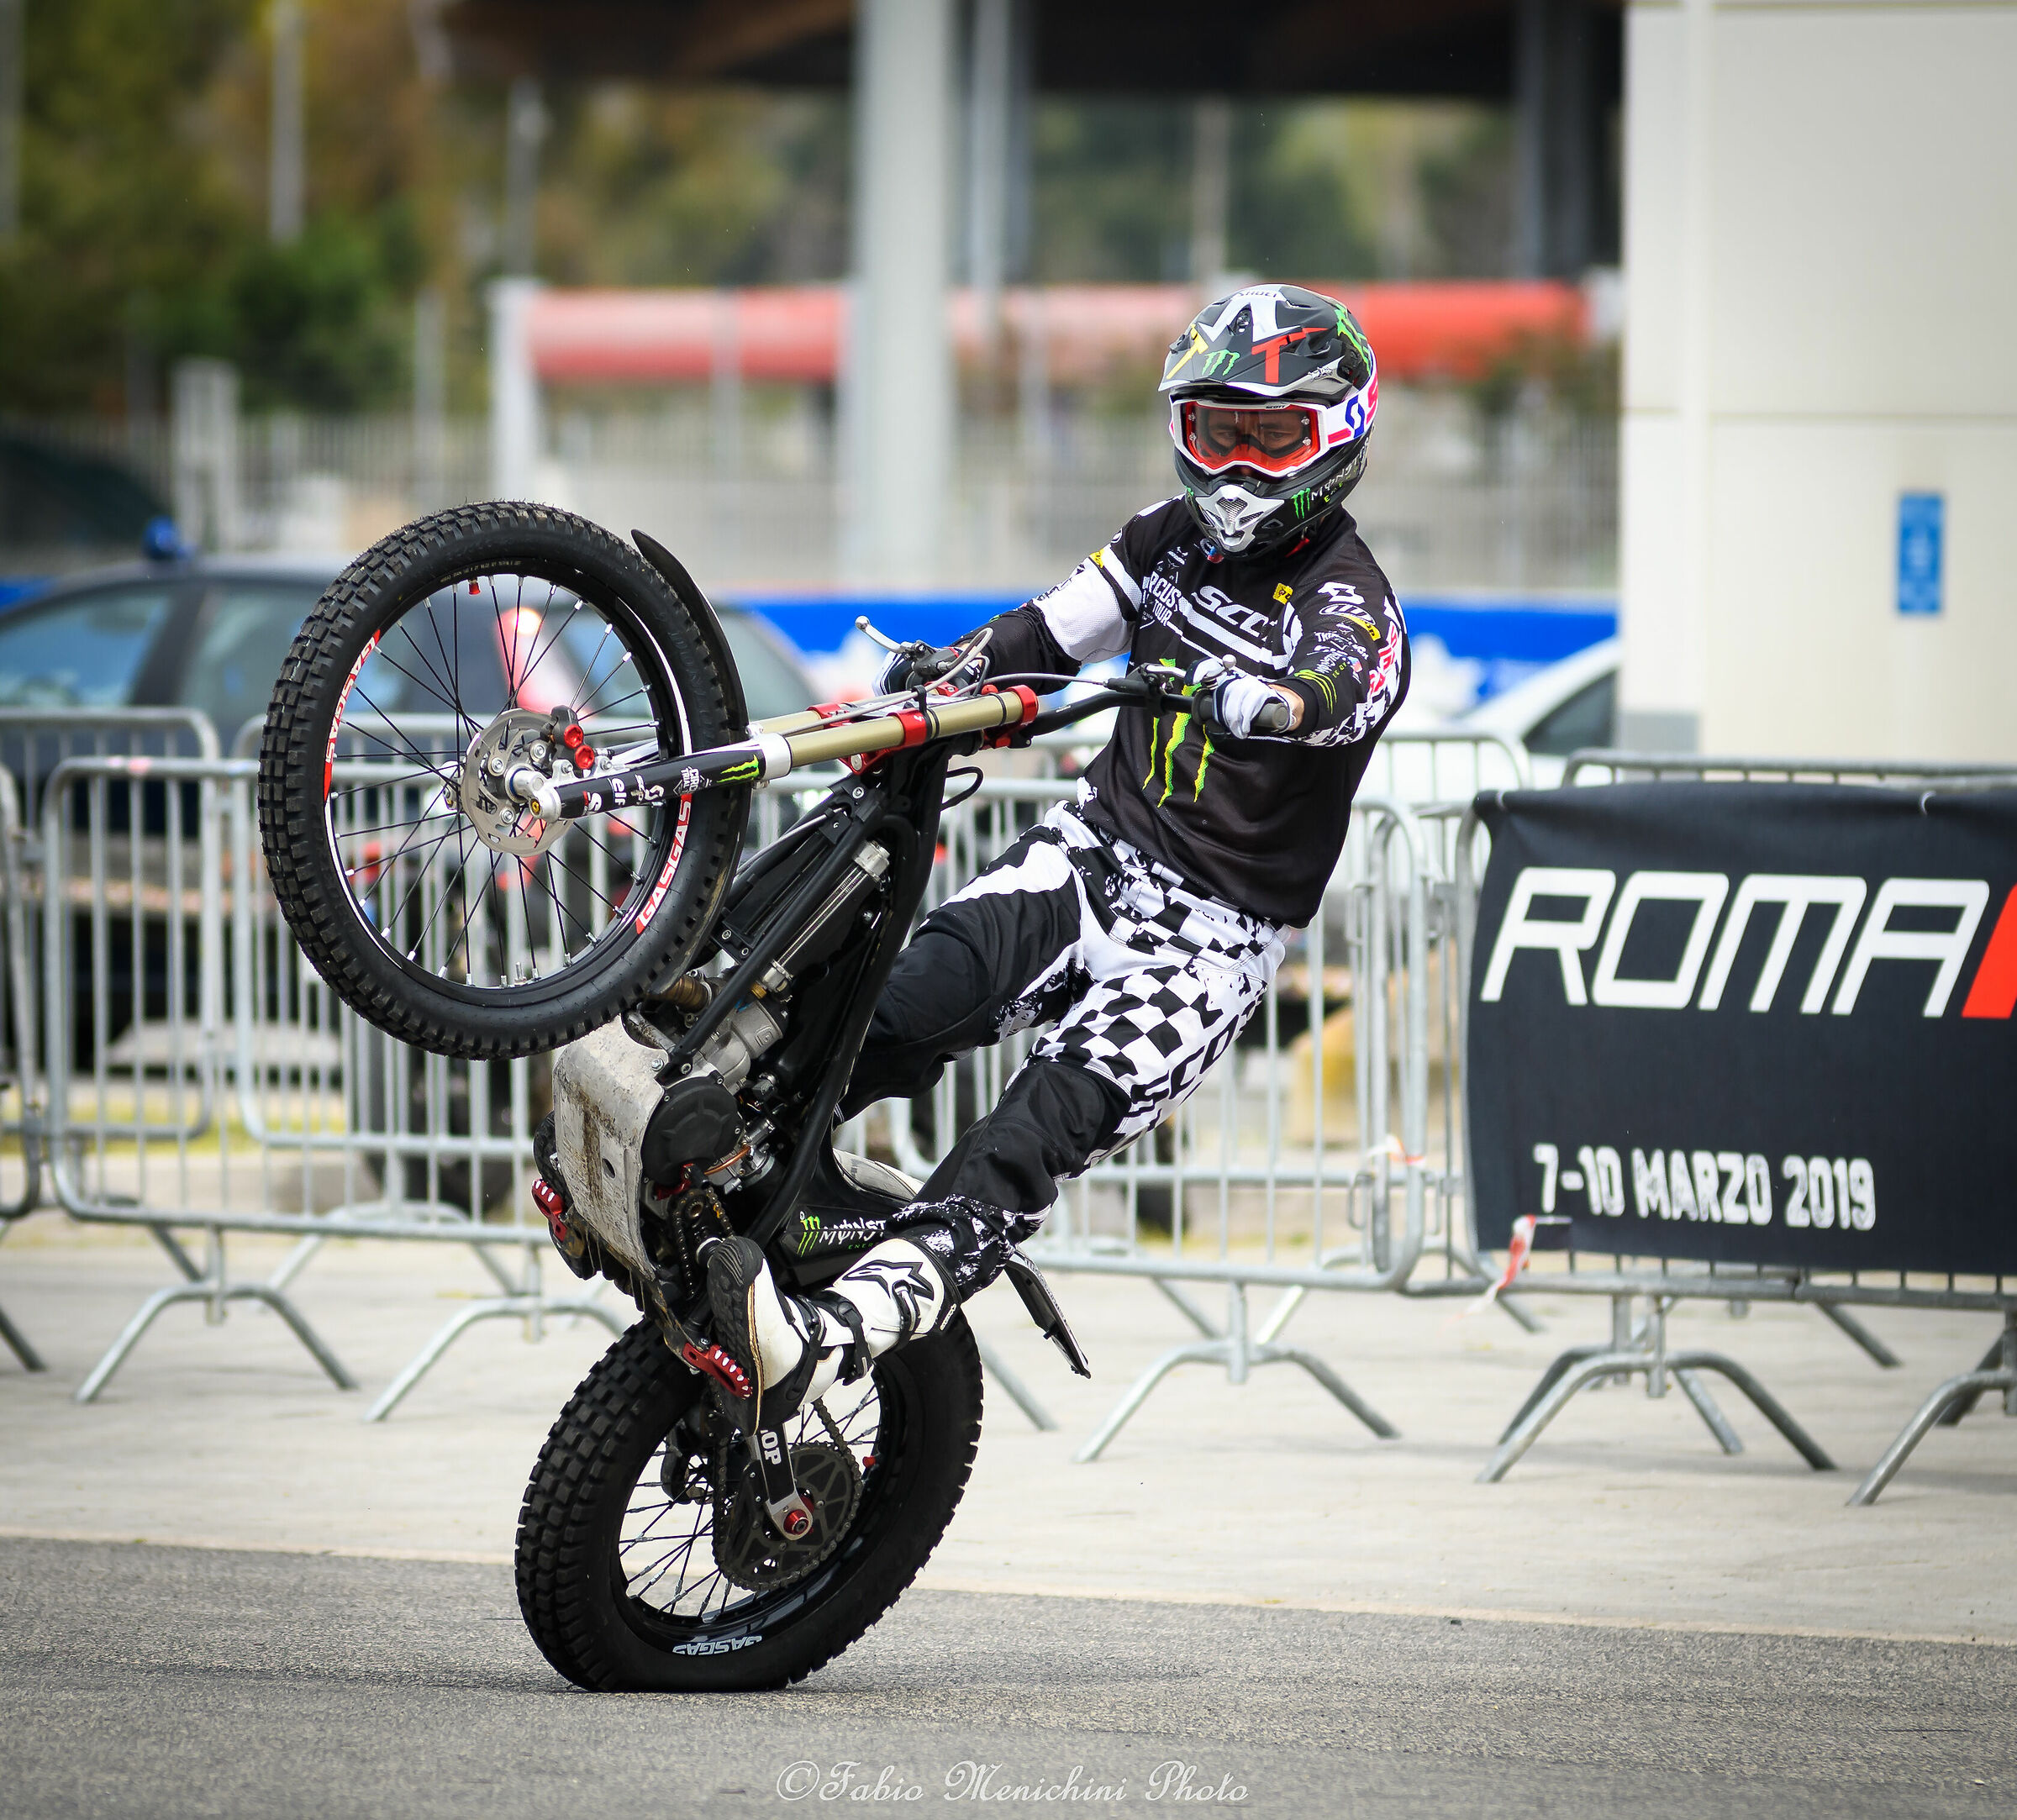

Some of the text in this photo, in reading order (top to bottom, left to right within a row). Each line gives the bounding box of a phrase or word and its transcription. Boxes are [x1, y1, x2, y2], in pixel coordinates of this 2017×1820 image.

[325, 636, 377, 764] GASGAS
[611, 777, 628, 807] elf
[639, 800, 692, 927] GASGAS
[1480, 866, 1990, 1018] ROMA
[819, 1218, 887, 1245] MONST
[1533, 1143, 1876, 1231] 7-10 MARZO 2019
